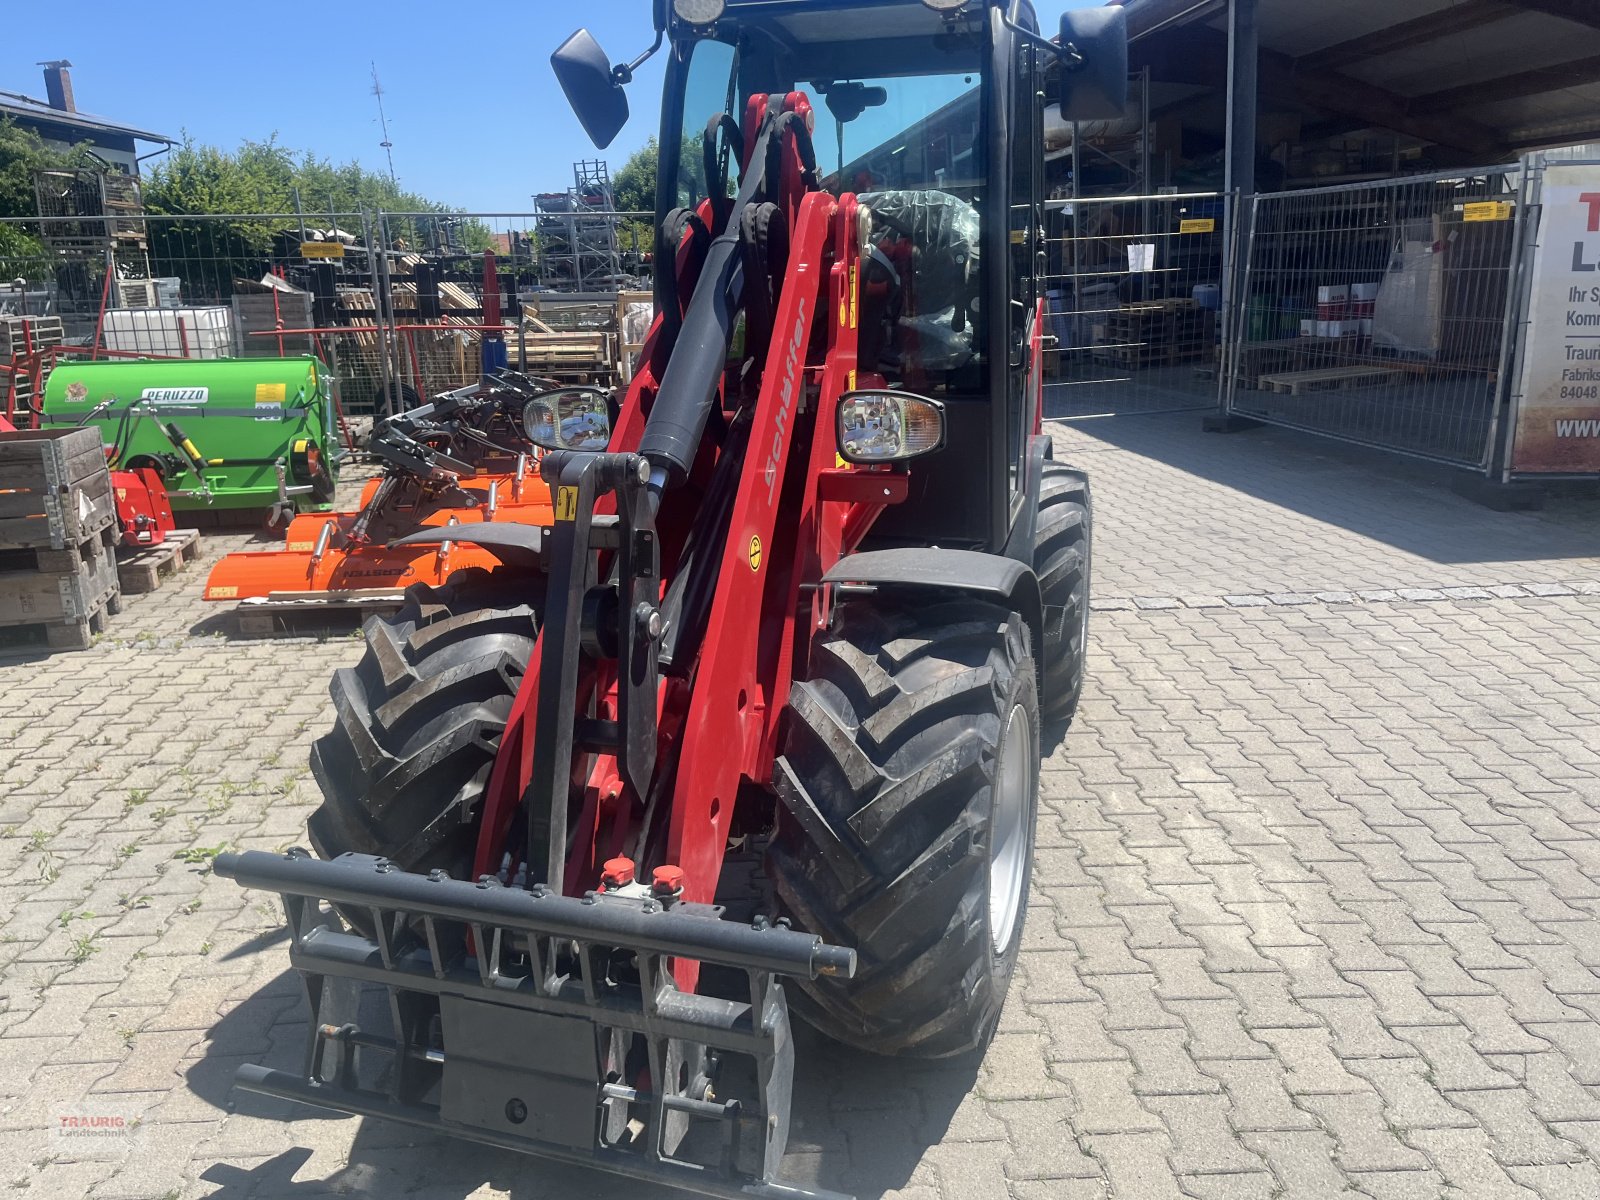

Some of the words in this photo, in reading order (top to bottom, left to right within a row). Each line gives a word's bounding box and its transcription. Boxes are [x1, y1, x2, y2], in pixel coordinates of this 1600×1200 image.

[1571, 242, 1600, 271] L
[1569, 286, 1587, 302] Ihr
[1590, 286, 1600, 306] S
[1566, 310, 1600, 326] Kom
[147, 390, 204, 401] PERUZZO
[1560, 386, 1598, 398] 84048
